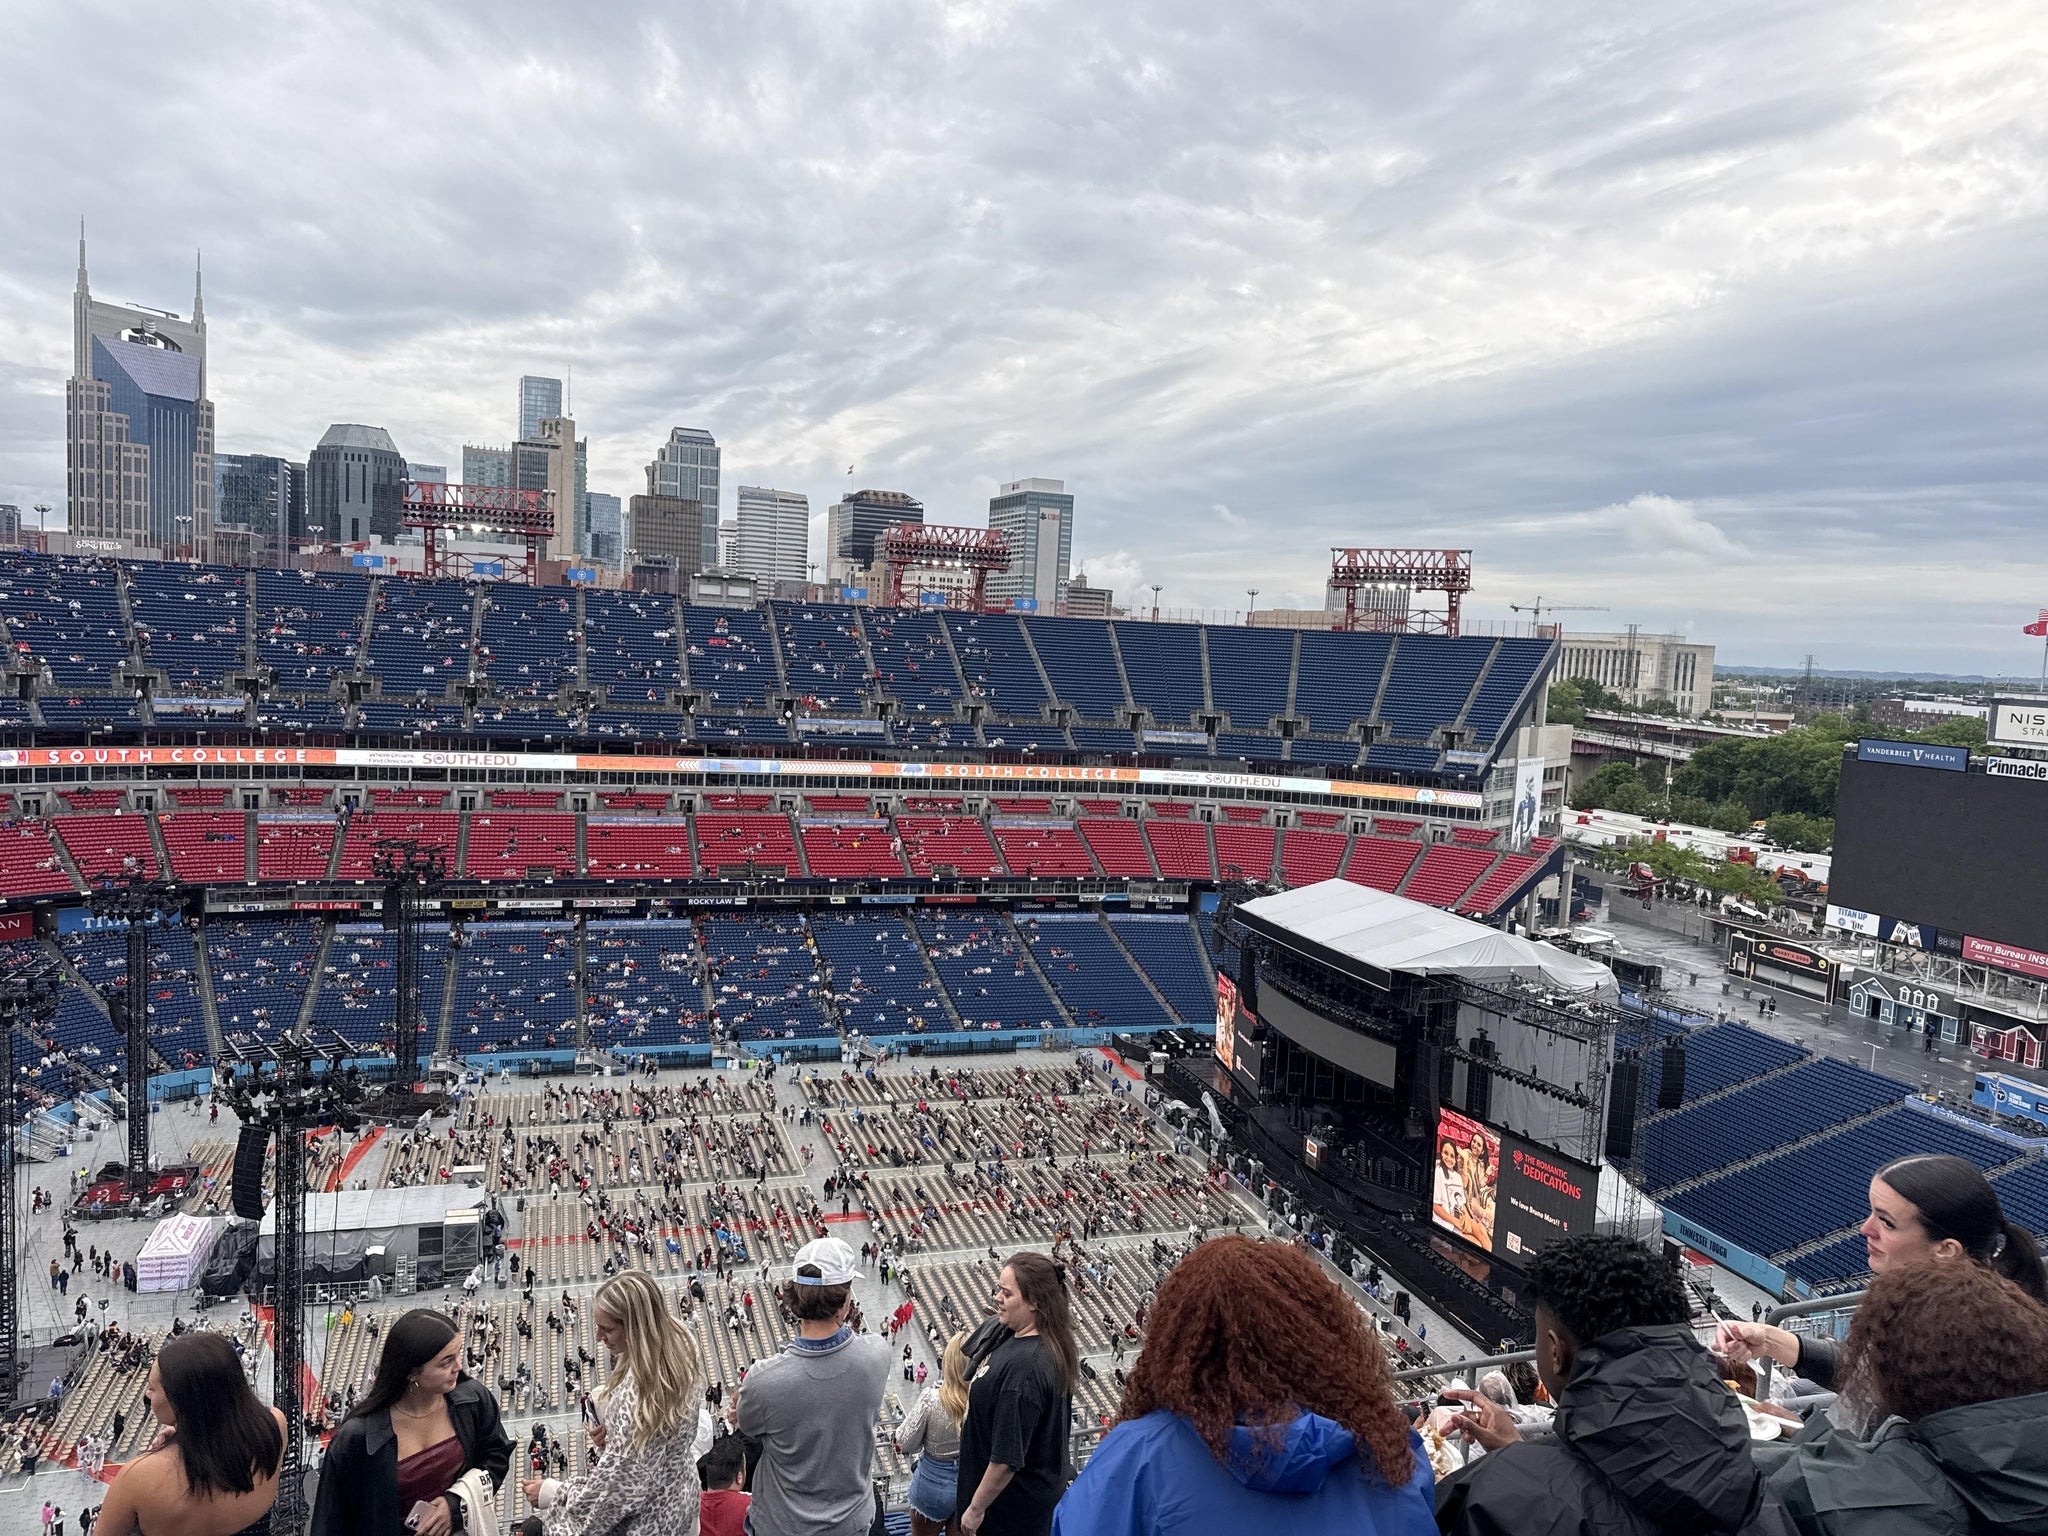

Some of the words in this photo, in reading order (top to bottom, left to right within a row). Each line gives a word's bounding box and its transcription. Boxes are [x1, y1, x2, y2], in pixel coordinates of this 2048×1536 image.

[49, 750, 153, 763] SOUTH
[171, 749, 306, 762] COLLEGE
[422, 753, 518, 766] SOUTH.EDU
[1867, 747, 1911, 757] VANDERBILT
[1925, 754, 1955, 762] HEALTH
[945, 765, 1013, 777] SOUTH
[1025, 767, 1118, 779] COLLEGE
[1988, 757, 2047, 778] Pinnacle
[1205, 773, 1281, 788] SOUTH.EDU
[1838, 907, 1857, 919] TITAN
[1858, 912, 1868, 921] UP
[1970, 940, 1992, 952] Farm
[1994, 945, 2026, 960] Bureau
[1524, 1153, 1535, 1165] THE
[1536, 1160, 1568, 1180] ROMANTIC
[1523, 1163, 1582, 1200] DEDICATIONS
[1510, 1196, 1518, 1206] We
[1519, 1201, 1529, 1212] love
[1529, 1206, 1543, 1219] Bruno
[1680, 1224, 1708, 1248] TENNESSEE
[1709, 1240, 1728, 1259] TOUGH
